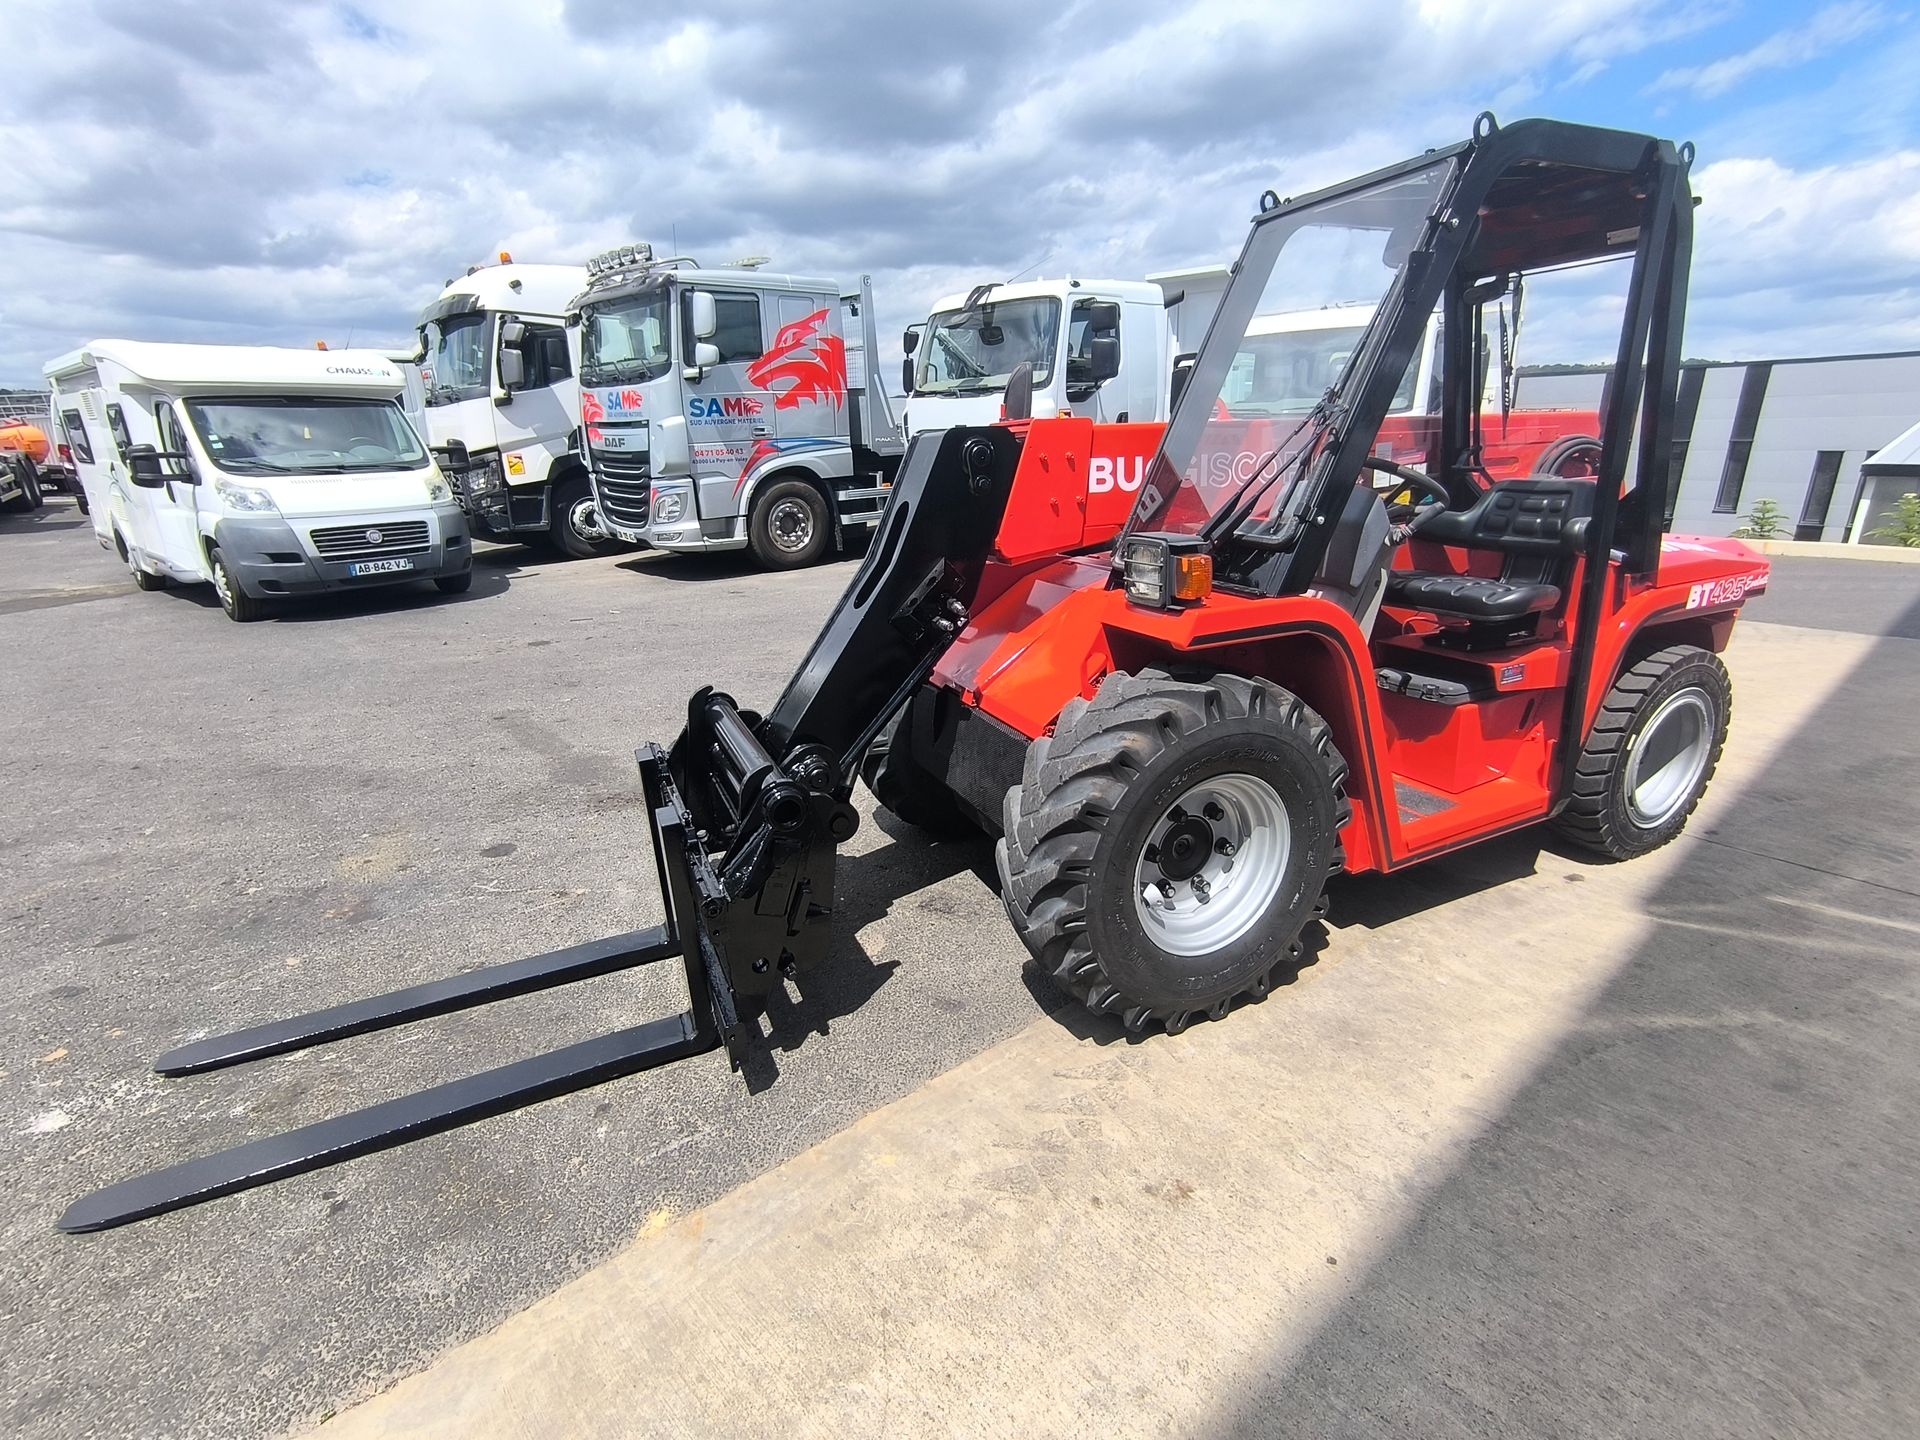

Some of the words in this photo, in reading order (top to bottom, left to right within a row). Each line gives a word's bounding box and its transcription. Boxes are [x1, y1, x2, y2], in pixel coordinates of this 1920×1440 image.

[608, 391, 631, 410] SAM
[689, 397, 743, 418] SAM
[604, 437, 625, 448] DAF
